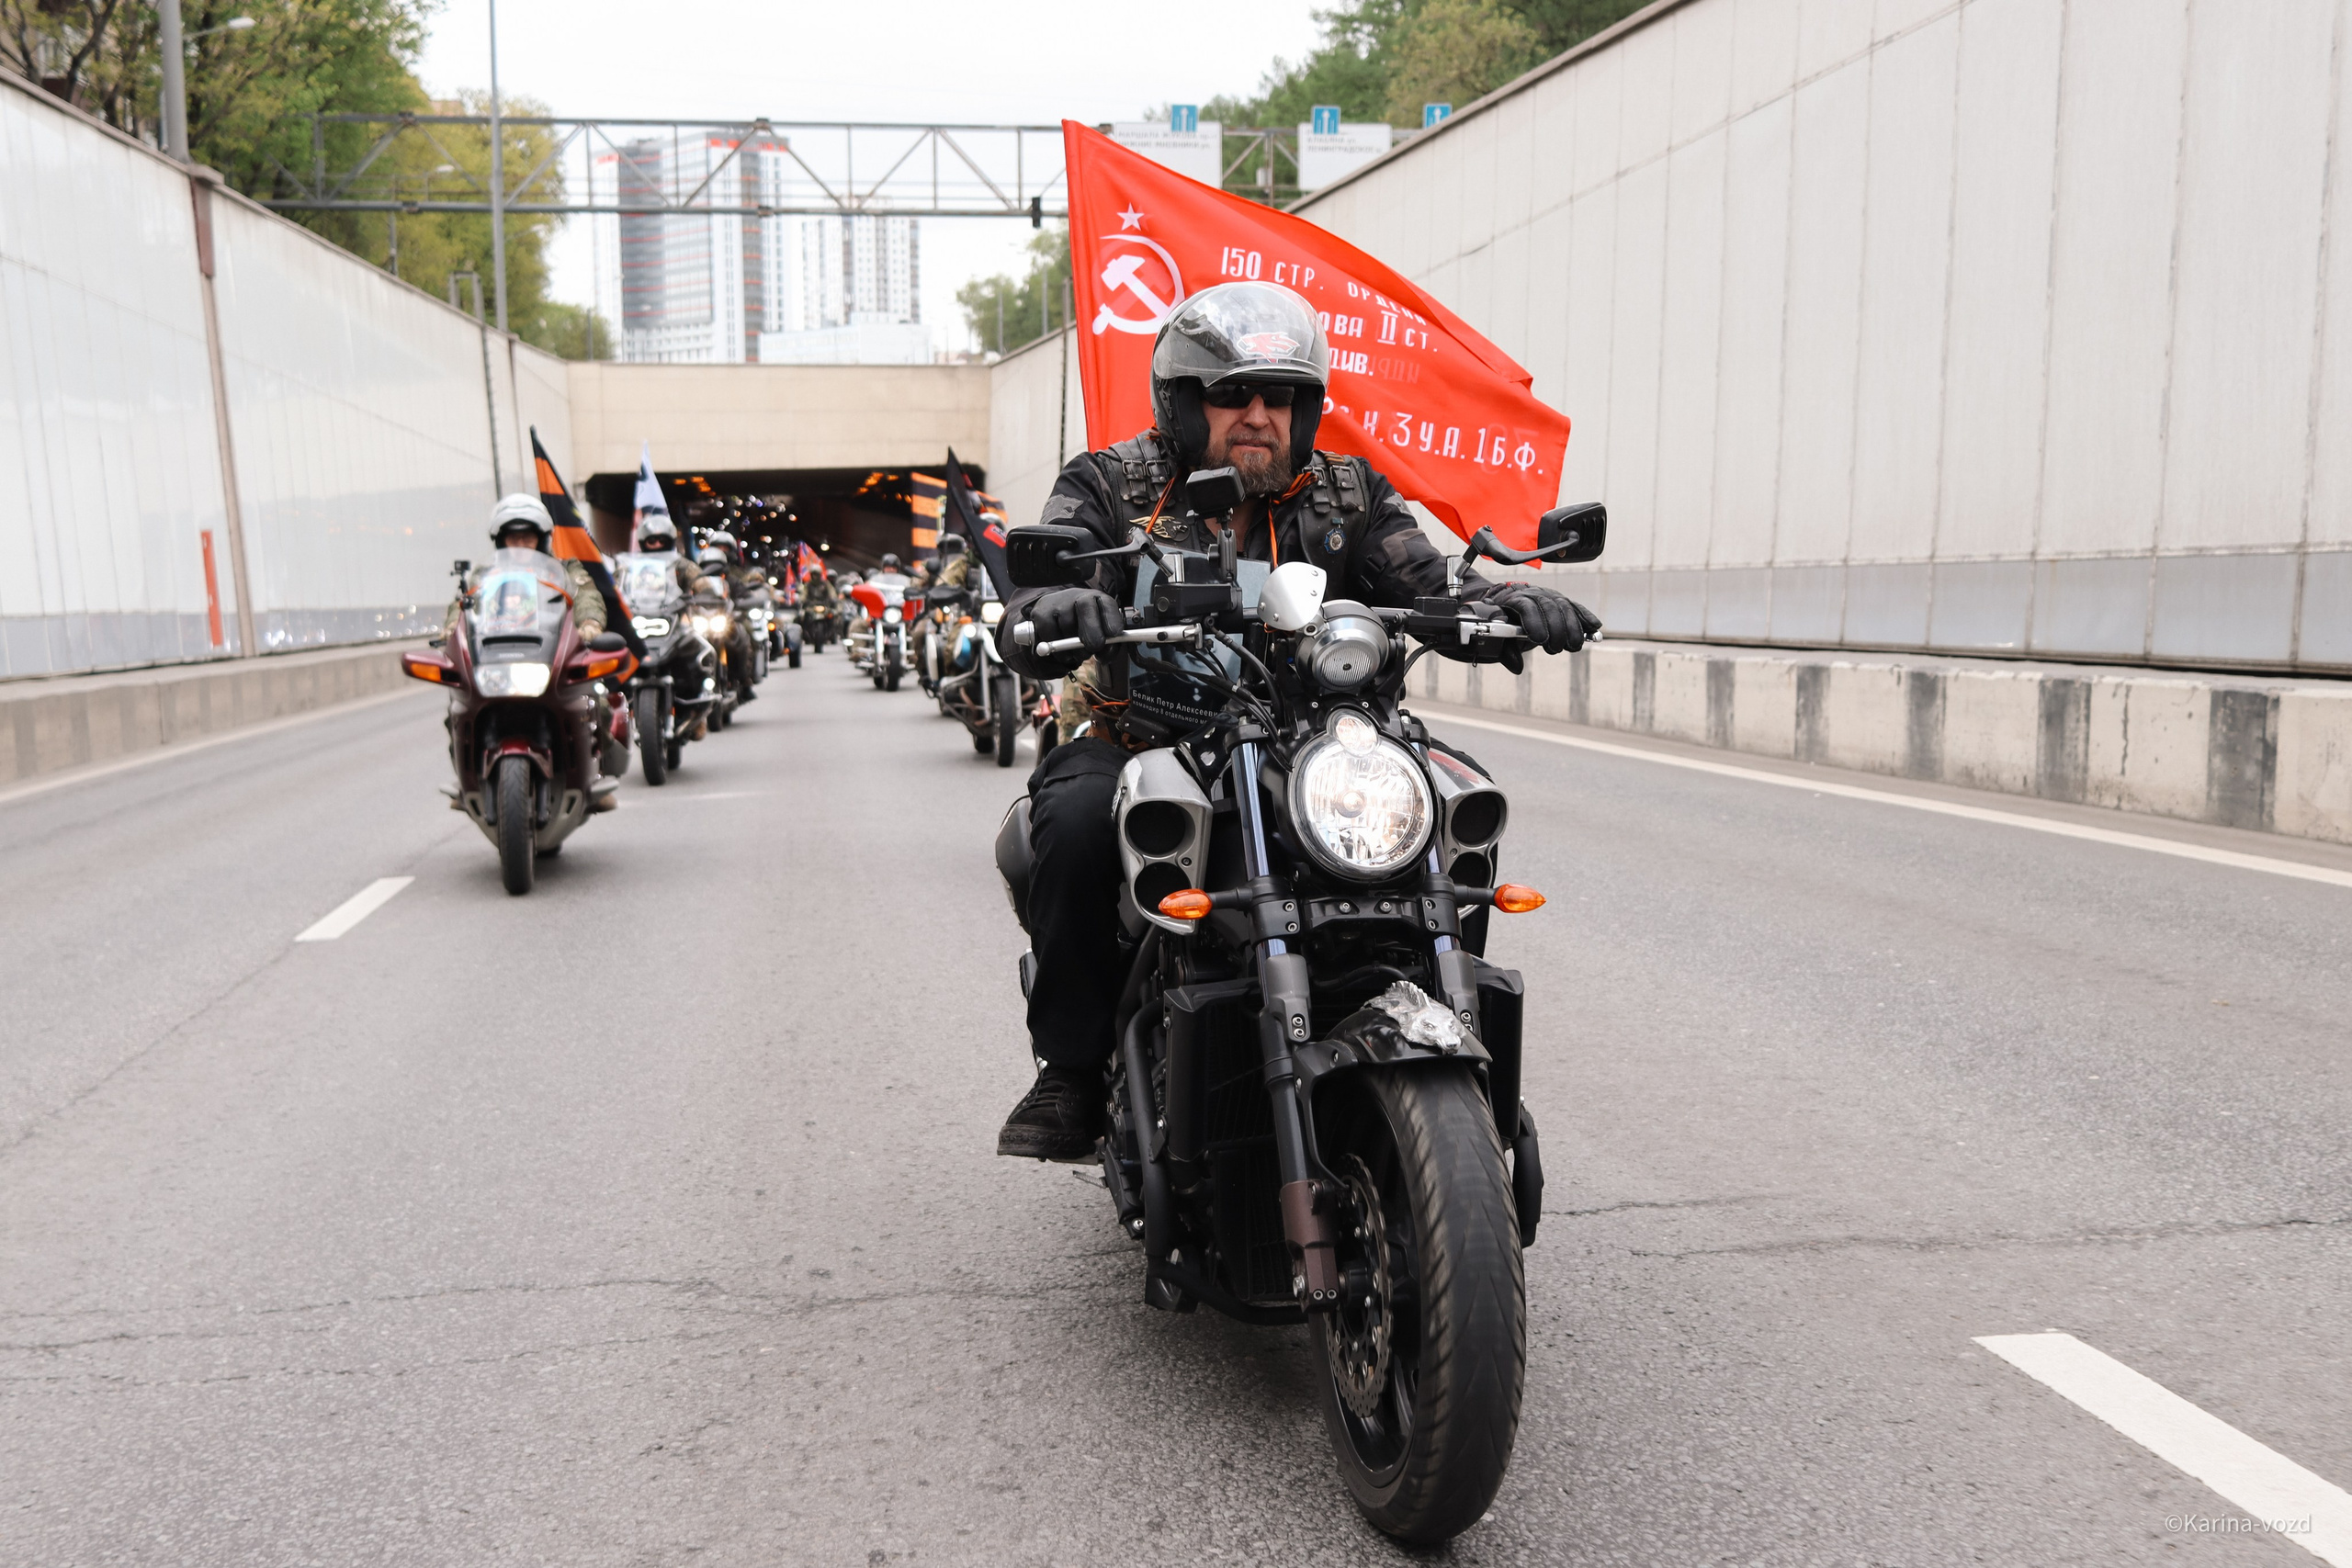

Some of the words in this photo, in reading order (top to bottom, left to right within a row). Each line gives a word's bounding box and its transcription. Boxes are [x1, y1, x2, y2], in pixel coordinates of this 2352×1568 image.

[1221, 246, 1262, 279] 150
[1274, 261, 1324, 290] СТР.
[1318, 310, 1364, 338] ОВА
[1405, 327, 1438, 353] СТ.
[1132, 689, 1155, 704] Белик
[1156, 696, 1175, 710] Петр
[1176, 703, 1218, 717] Алексееви
[1132, 700, 1159, 715] командир
[1164, 710, 1199, 724] отдельного
